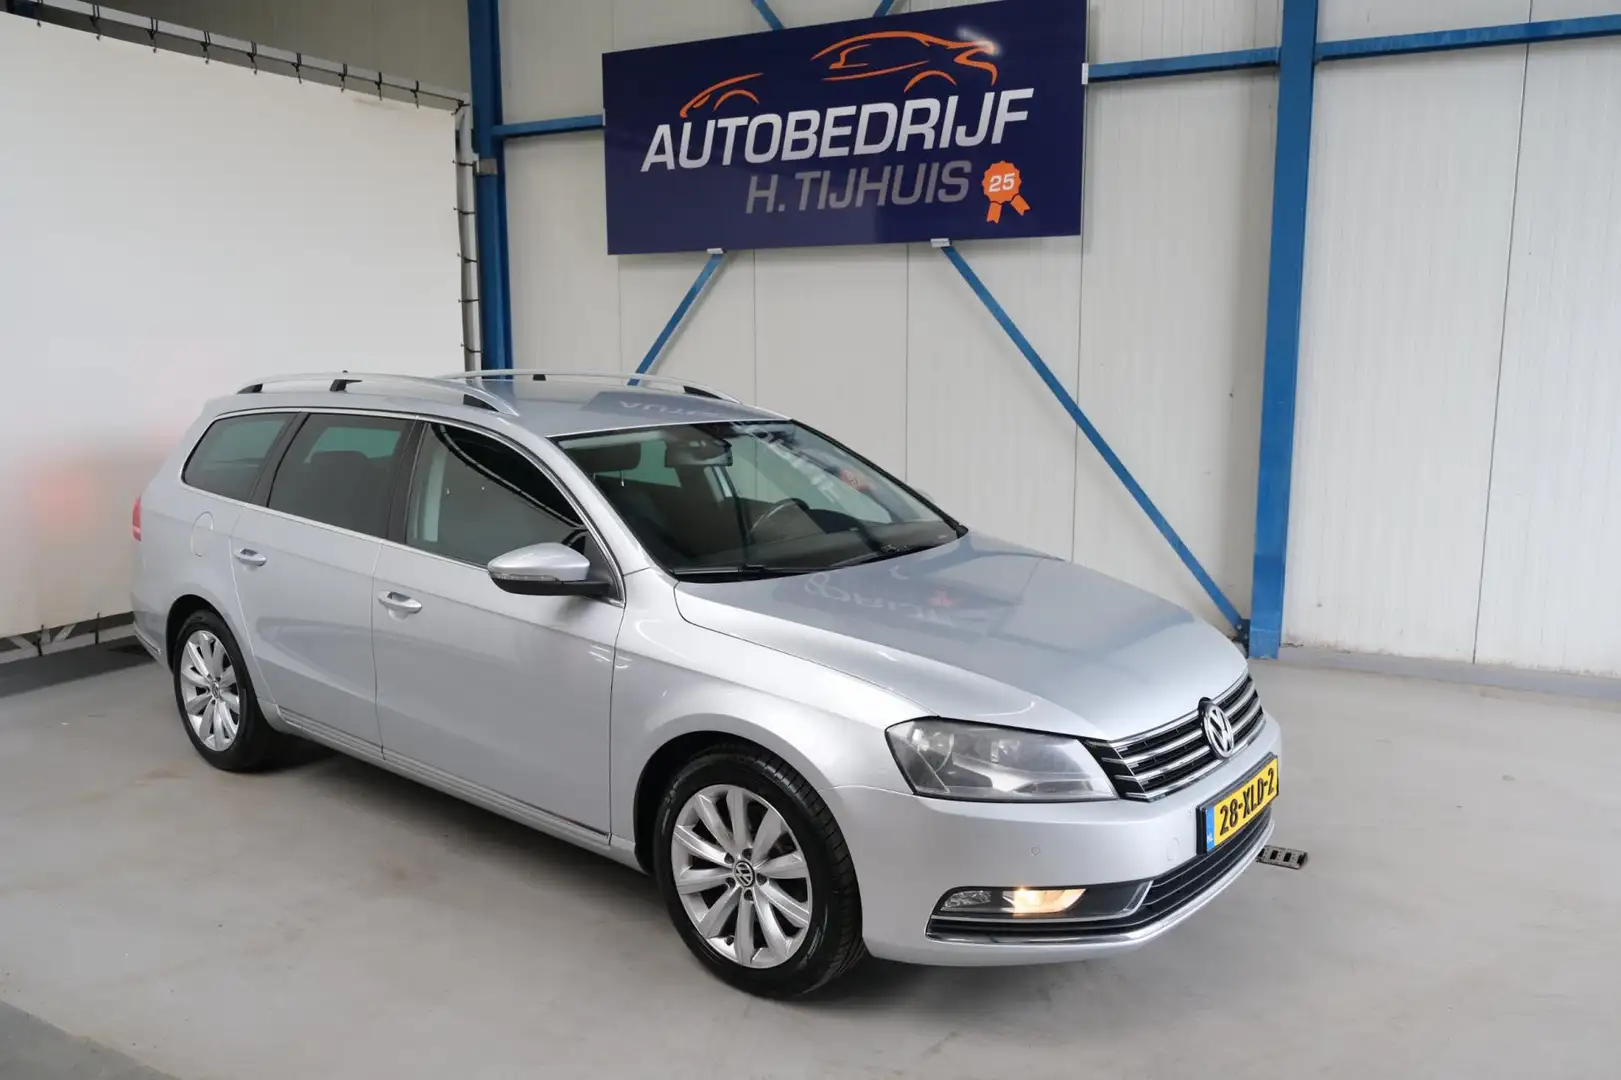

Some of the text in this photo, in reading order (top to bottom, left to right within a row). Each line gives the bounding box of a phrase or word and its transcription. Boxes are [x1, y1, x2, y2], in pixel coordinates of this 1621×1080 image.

[640, 87, 1035, 172] AUTOBEDRIJF
[745, 160, 972, 214] H. TIJHUIS
[989, 173, 1016, 193] 25
[1219, 767, 1275, 836] 28-XLD-2
